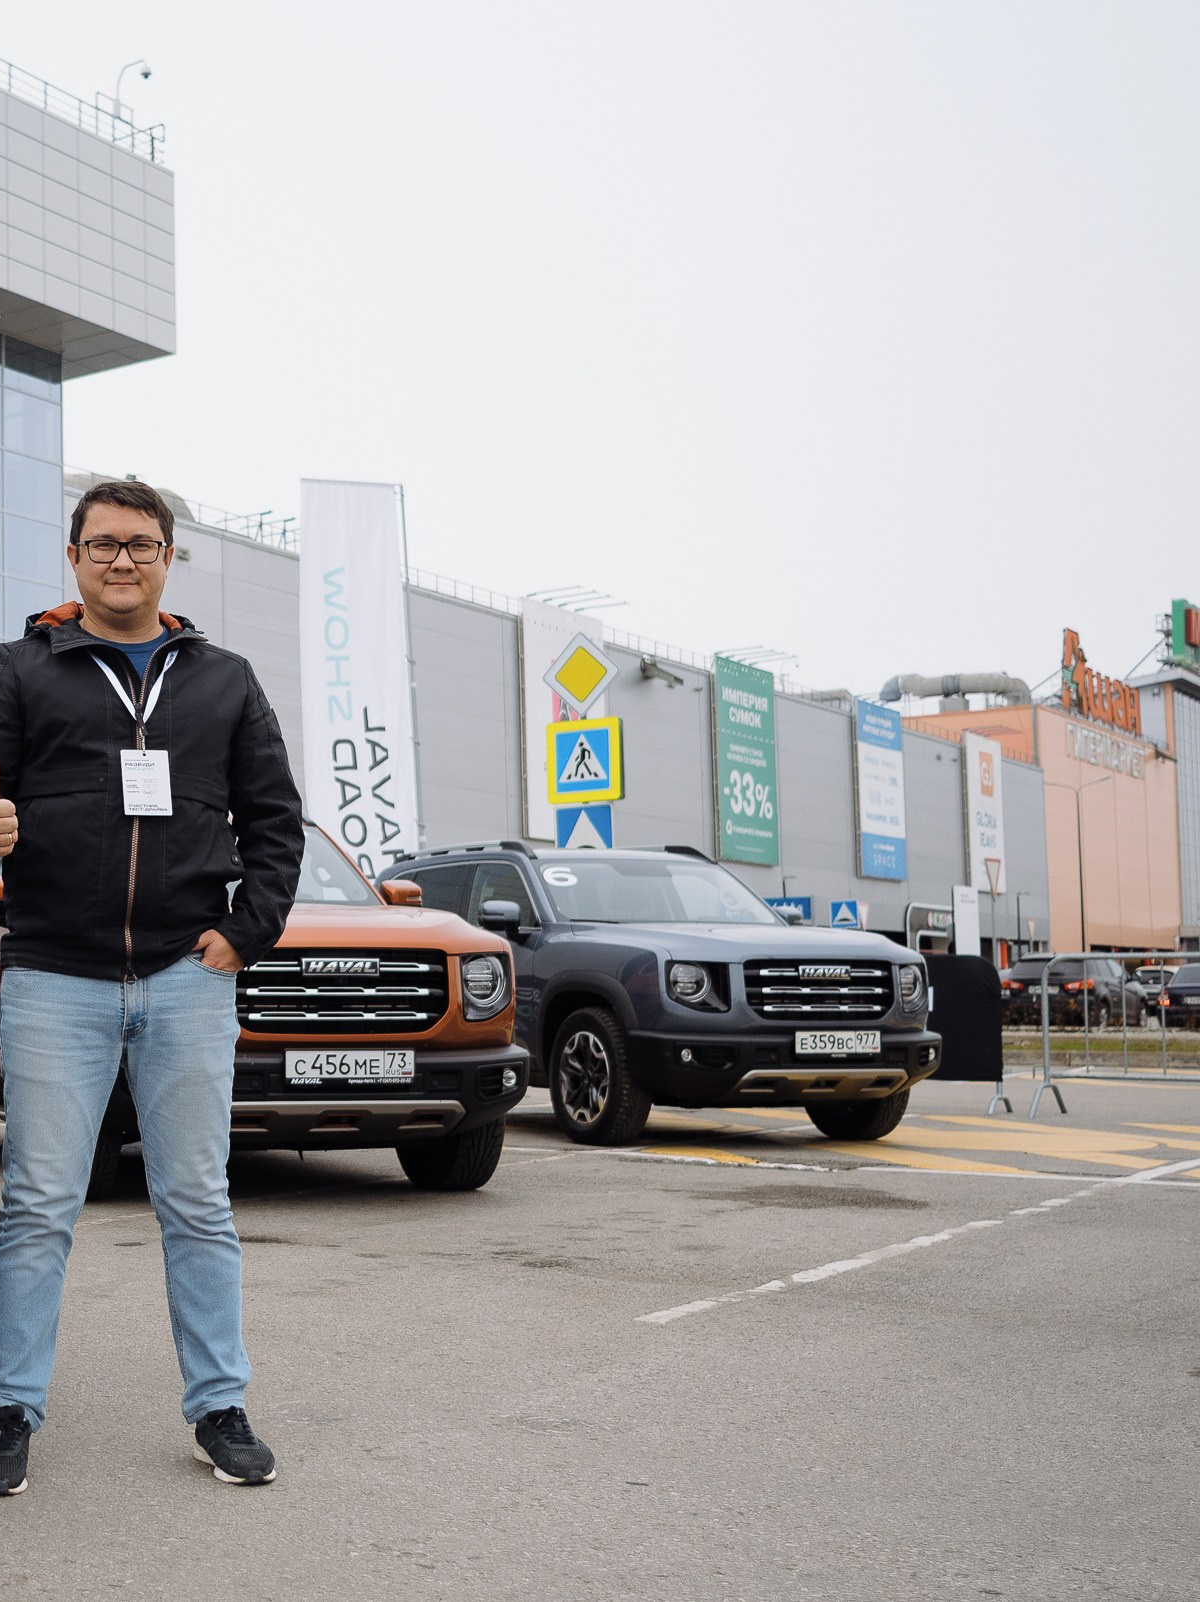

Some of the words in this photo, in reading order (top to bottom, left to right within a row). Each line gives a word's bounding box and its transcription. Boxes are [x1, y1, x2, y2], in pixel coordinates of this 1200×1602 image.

[722, 686, 768, 712] ИМПЕРИЯ
[728, 706, 762, 728] СУМОК
[723, 769, 773, 819] -33%
[542, 866, 578, 887] 6
[308, 961, 376, 973] HAVAL
[803, 968, 849, 977] HAVAL
[856, 1033, 876, 1045] 977
[386, 1052, 407, 1069] 73
